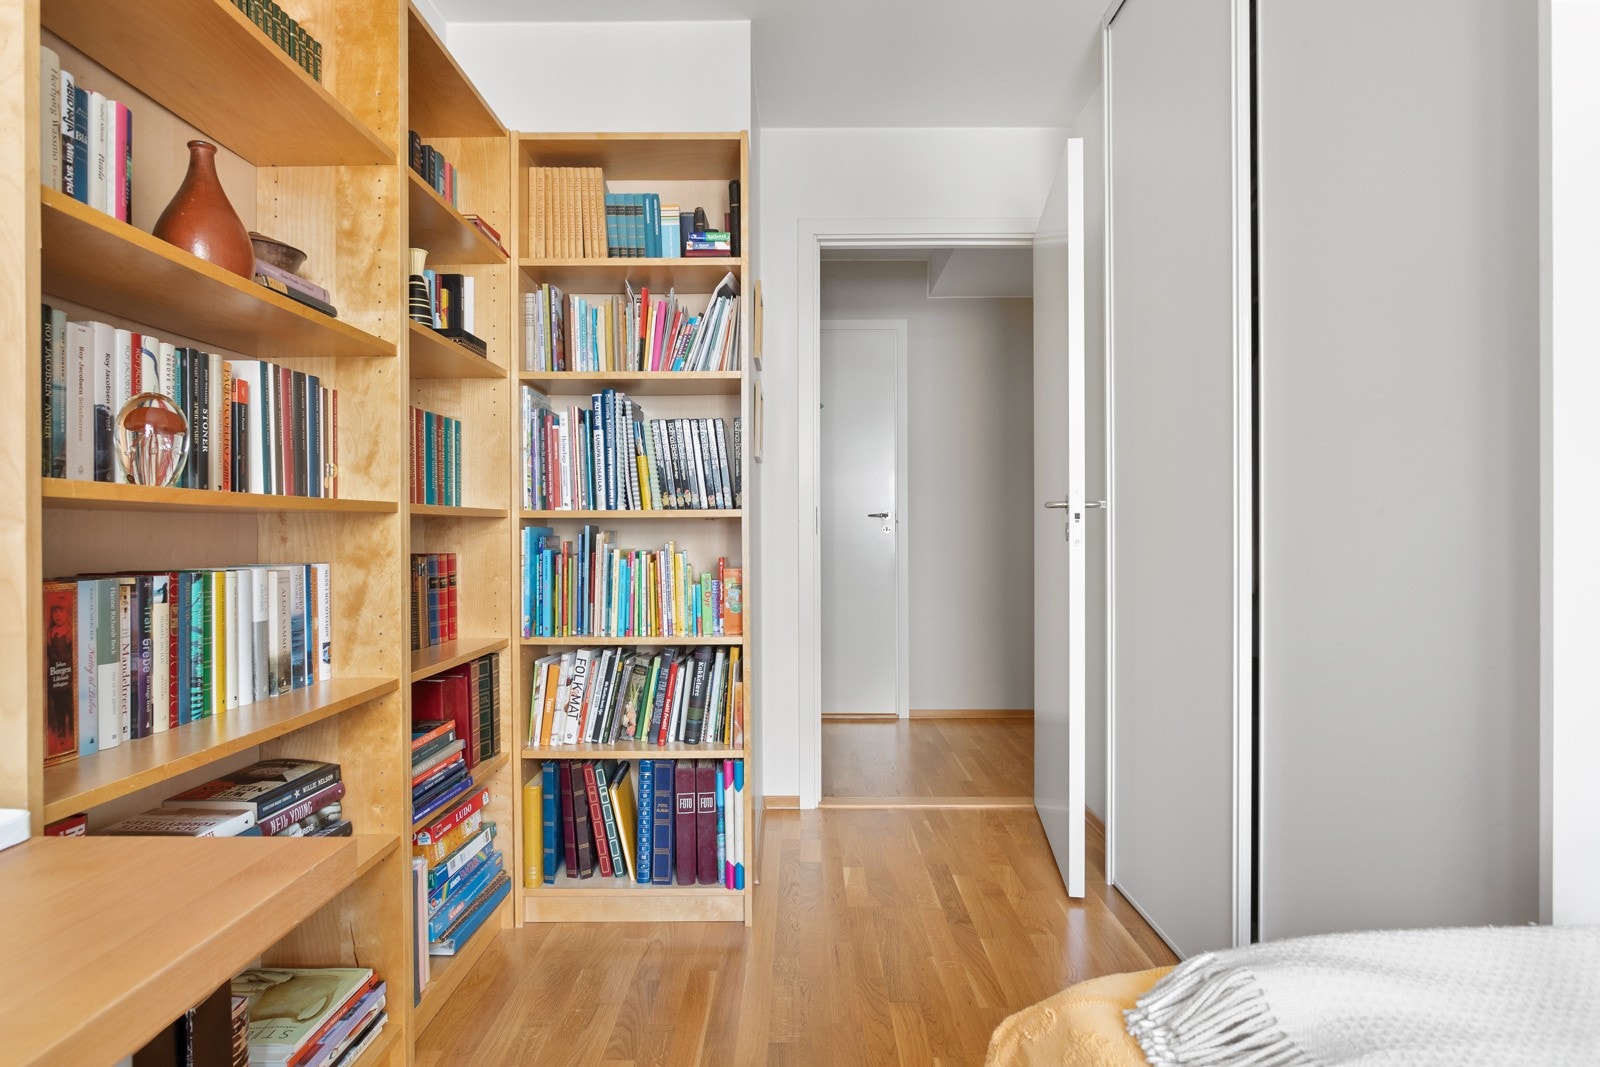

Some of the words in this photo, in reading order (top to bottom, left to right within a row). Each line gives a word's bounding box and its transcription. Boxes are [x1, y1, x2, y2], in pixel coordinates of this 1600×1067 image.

[66, 80, 75, 108] ABID
[63, 108, 75, 132] RAJA
[51, 120, 59, 161] Wassmo
[66, 143, 75, 164] Min
[64, 165, 75, 193] skyld
[98, 154, 106, 182] Paula
[45, 323, 53, 342] ROY
[45, 346, 53, 397] JACOBSEN
[142, 638, 152, 673] Grebe
[50, 666, 72, 676] Borgen
[122, 643, 130, 714] Mandeltreet
[572, 658, 586, 691] FOLK
[694, 662, 704, 696] Kokkelære
[568, 696, 582, 720] MAT
[303, 781, 318, 794] WILLIE
[318, 773, 334, 786] NELSON
[456, 804, 472, 822] LUDO
[680, 798, 692, 809] FOTO
[700, 797, 713, 808] FOTO
[270, 814, 288, 836] NEIL
[288, 801, 312, 824] YOUNG
